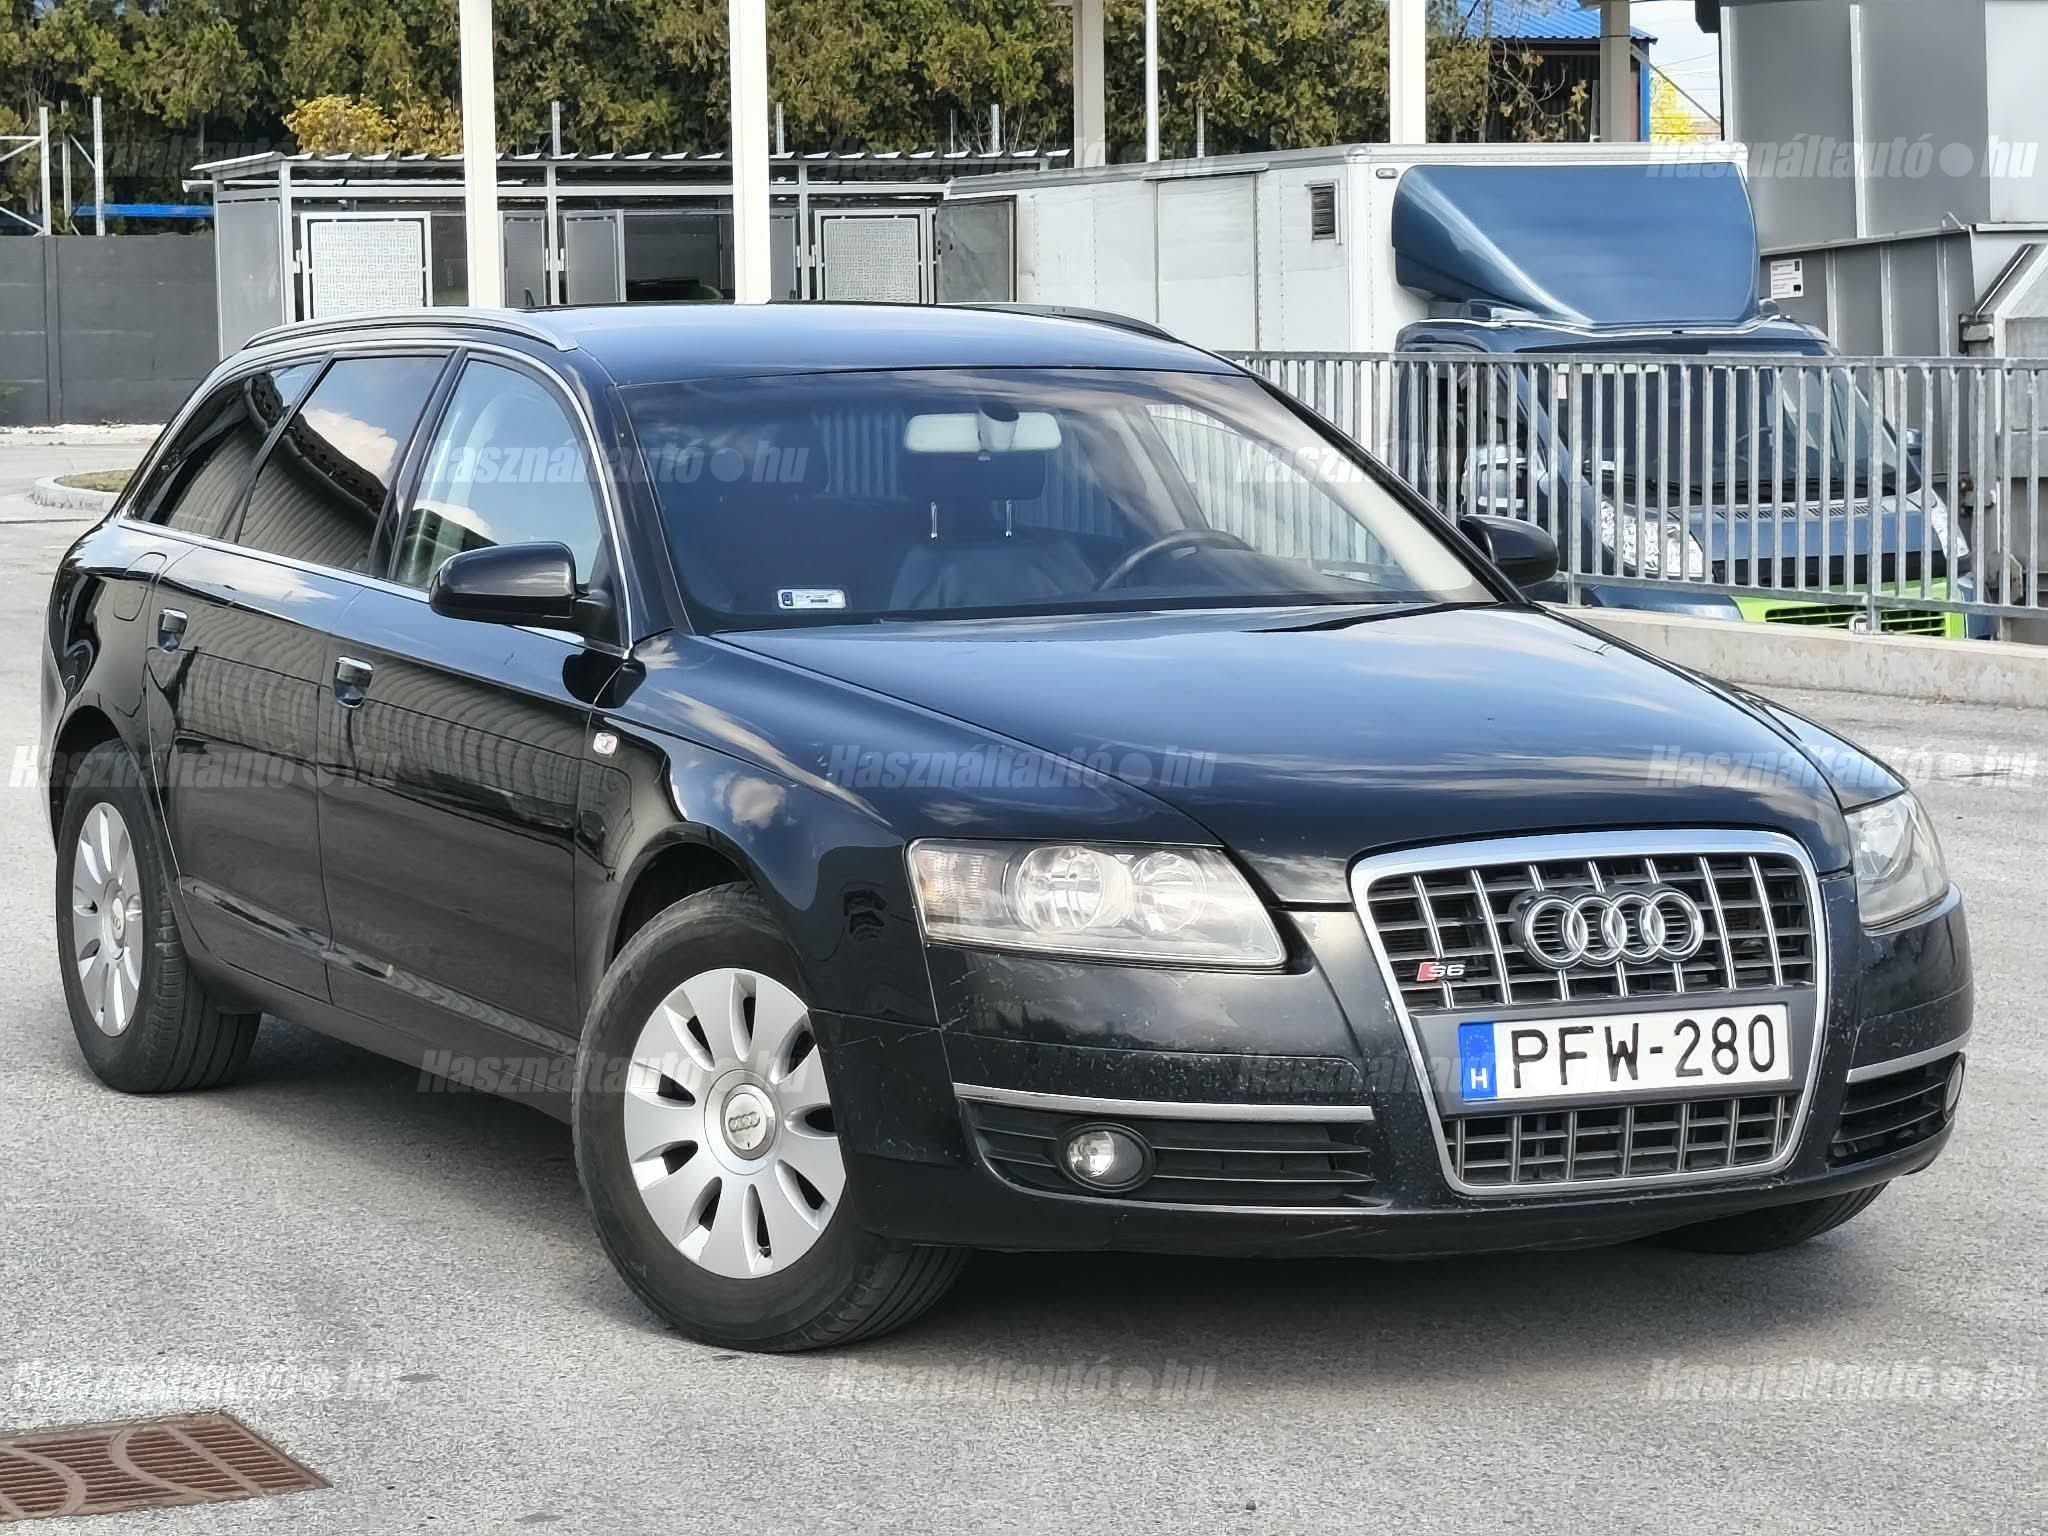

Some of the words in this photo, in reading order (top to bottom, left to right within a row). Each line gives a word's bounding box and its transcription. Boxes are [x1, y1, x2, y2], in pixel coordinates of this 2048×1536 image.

[1420, 962, 1466, 979] S6
[1510, 1013, 1776, 1089] PFW-280
[1470, 1067, 1487, 1089] H
